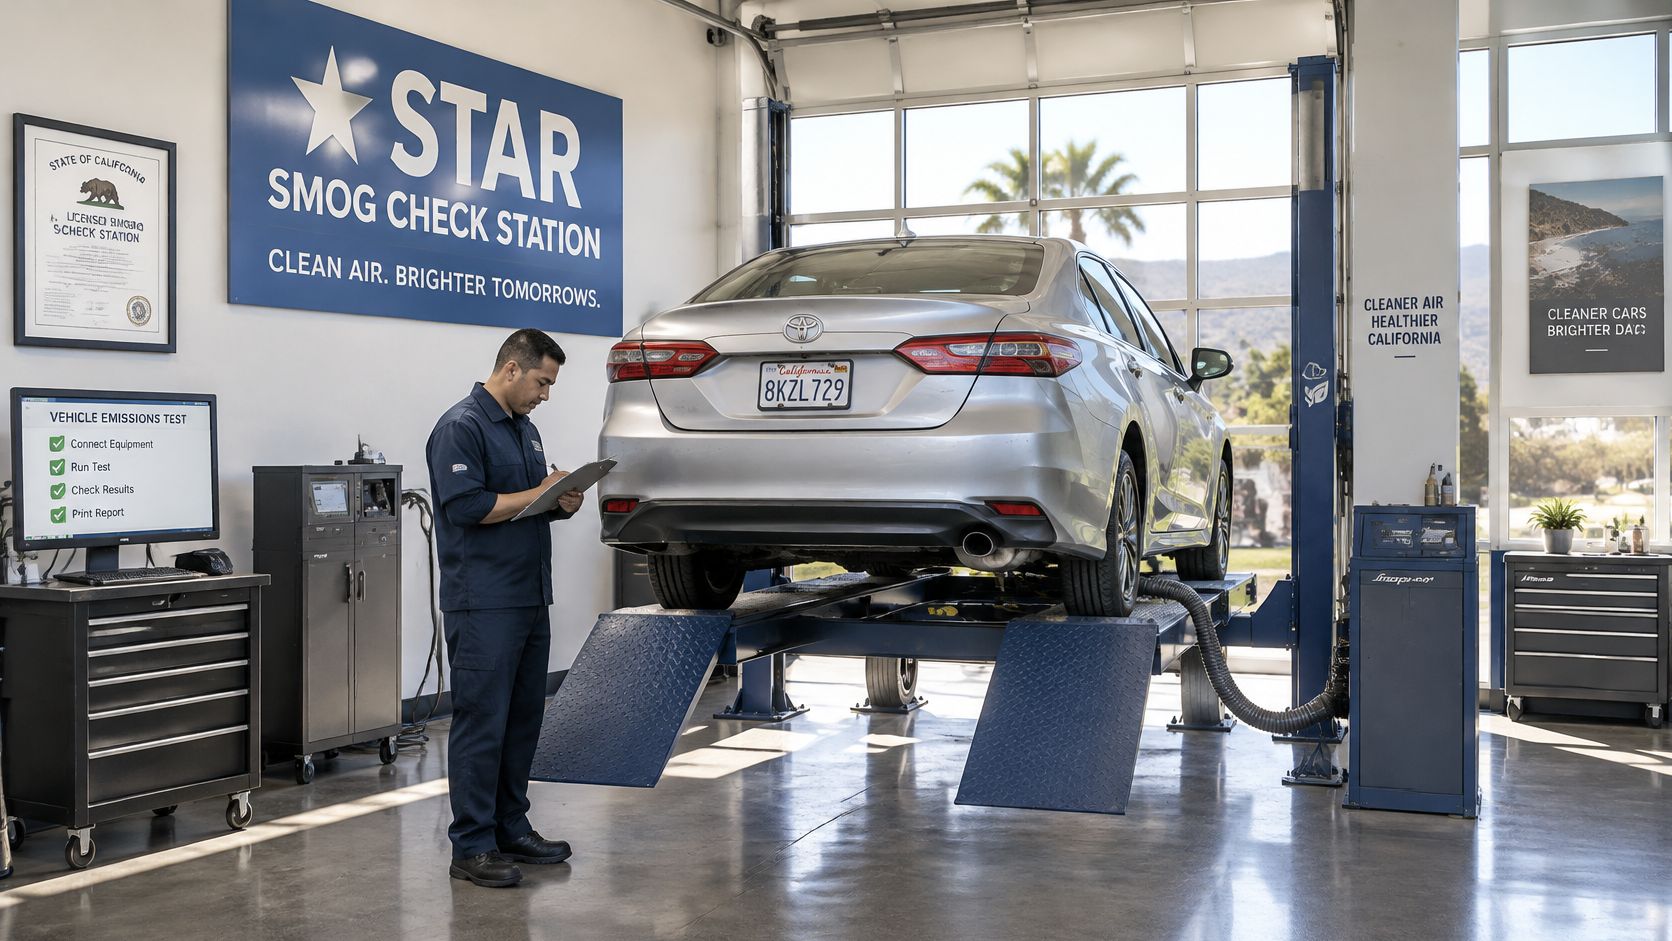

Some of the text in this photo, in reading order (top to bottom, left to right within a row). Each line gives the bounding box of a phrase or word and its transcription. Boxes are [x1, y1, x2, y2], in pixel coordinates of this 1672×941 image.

[390, 69, 582, 209] STAR
[49, 155, 77, 171] STATE
[80, 154, 92, 164] OF
[268, 168, 601, 260] SMOG CHECK STATION
[99, 229, 140, 243] STATION
[268, 248, 601, 309] CLEAN AIR. BRIGHTER TOMORROWS.
[1364, 295, 1444, 311] CLEANER AIR
[1547, 306, 1647, 320] CLEANER CARS
[1371, 313, 1438, 328] HEALTHIER
[1547, 324, 1611, 336] BRIGHTER
[1368, 331, 1442, 345] CALIFORNIA
[764, 378, 844, 402] 8KZL729
[50, 411, 187, 424] VEHICLE EMISSIONS TEST
[71, 439, 154, 451] Connect Equipment
[71, 461, 111, 472] Run Test
[71, 485, 101, 495] Check
[72, 508, 125, 519] Print Report
